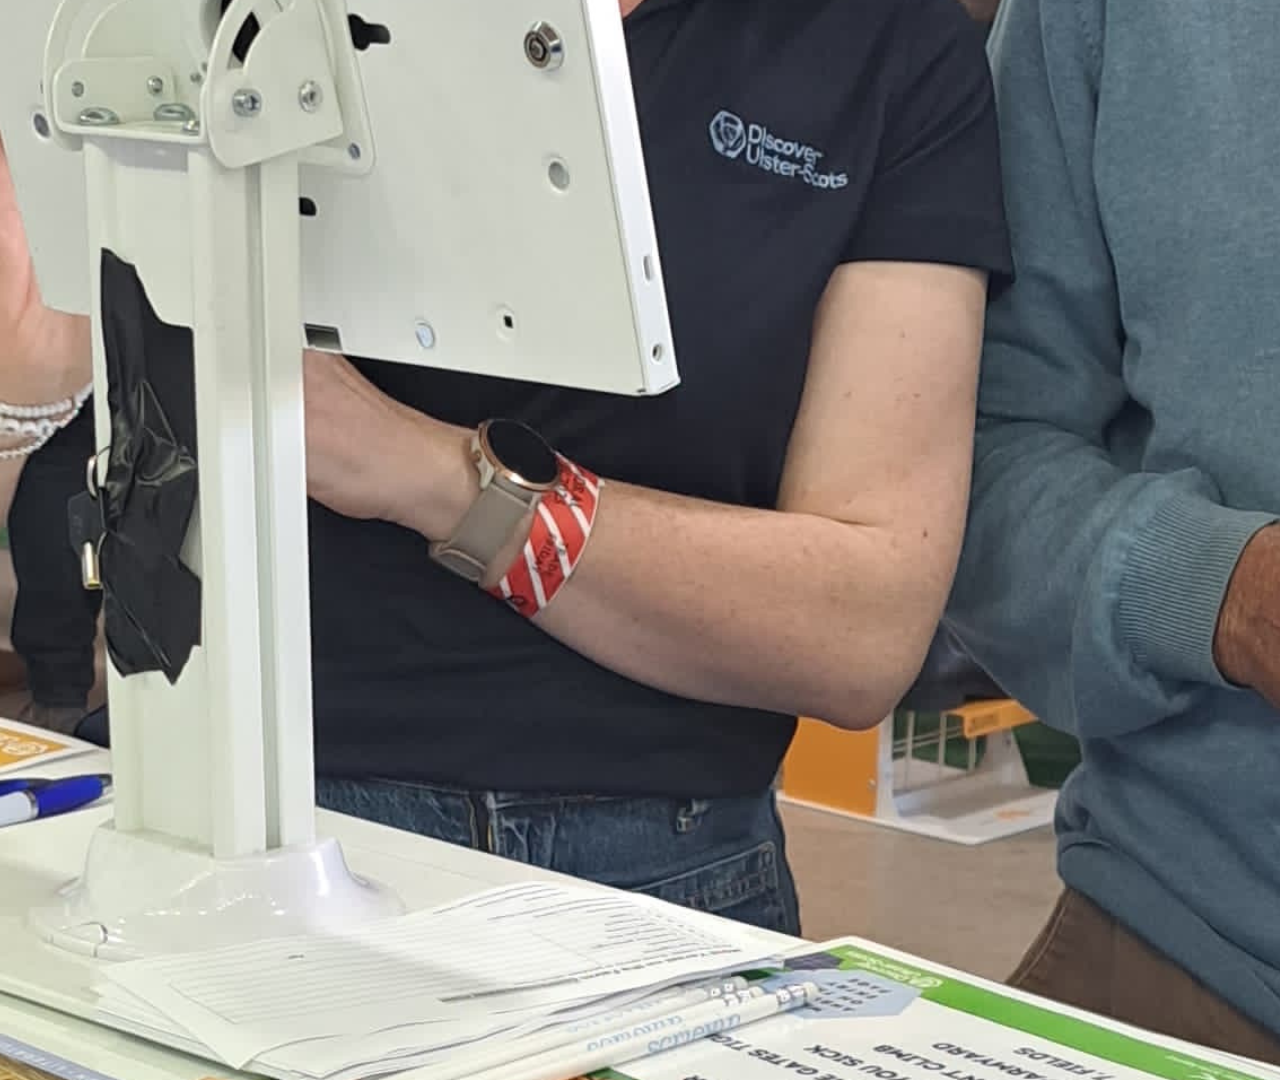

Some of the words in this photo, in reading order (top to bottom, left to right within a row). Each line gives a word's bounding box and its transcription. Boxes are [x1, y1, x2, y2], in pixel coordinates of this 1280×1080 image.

[748, 124, 823, 164] Discover
[746, 142, 849, 189] Ulster-Scots
[704, 1033, 753, 1052] TIG
[803, 1045, 865, 1068] SICK
[747, 1049, 819, 1076] GATES
[872, 1045, 947, 1071] CLIMB
[931, 1043, 1047, 1080] ARMYARD
[1012, 1047, 1097, 1076] FIELDS
